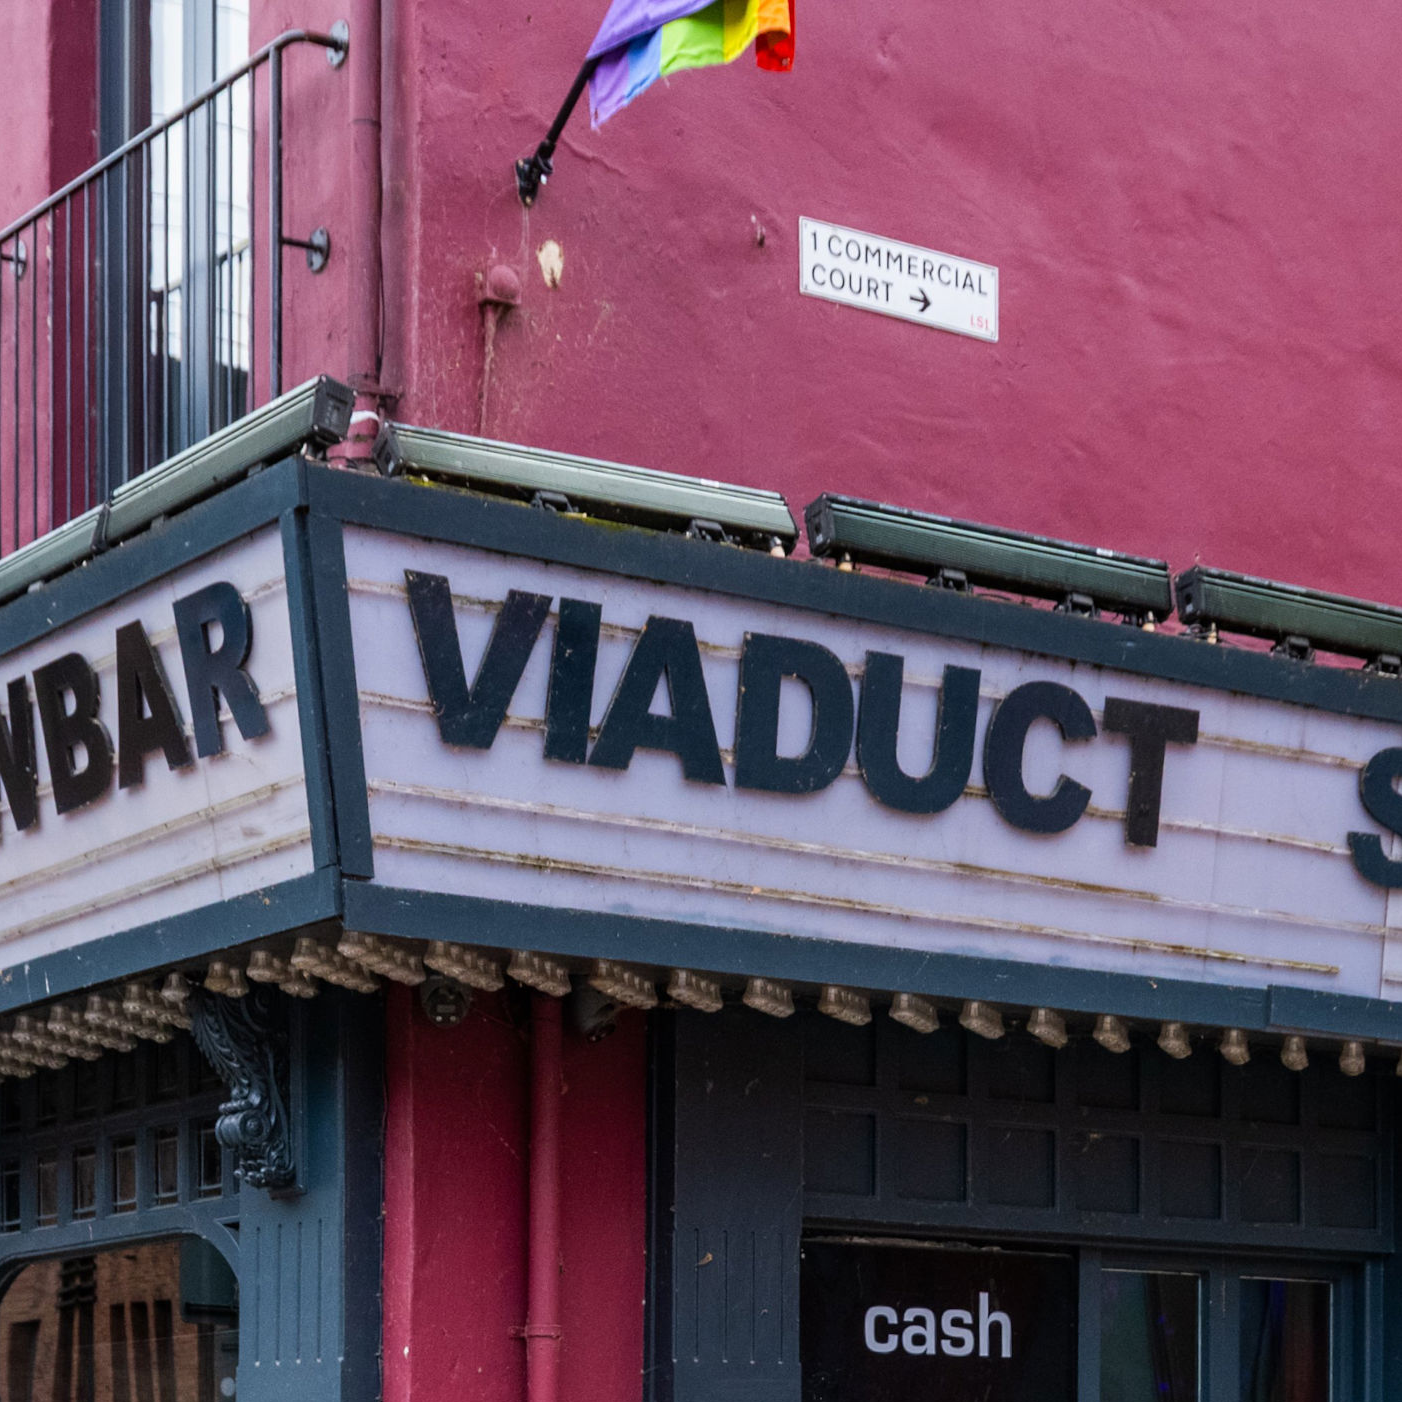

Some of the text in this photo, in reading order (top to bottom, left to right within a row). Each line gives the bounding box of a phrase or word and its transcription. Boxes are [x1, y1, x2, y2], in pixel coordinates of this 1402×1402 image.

[810, 231, 989, 297] 1 COMMERCIAL
[811, 263, 894, 302] COURT
[403, 568, 1200, 848] VIADUCT
[864, 1291, 1013, 1359] cash
